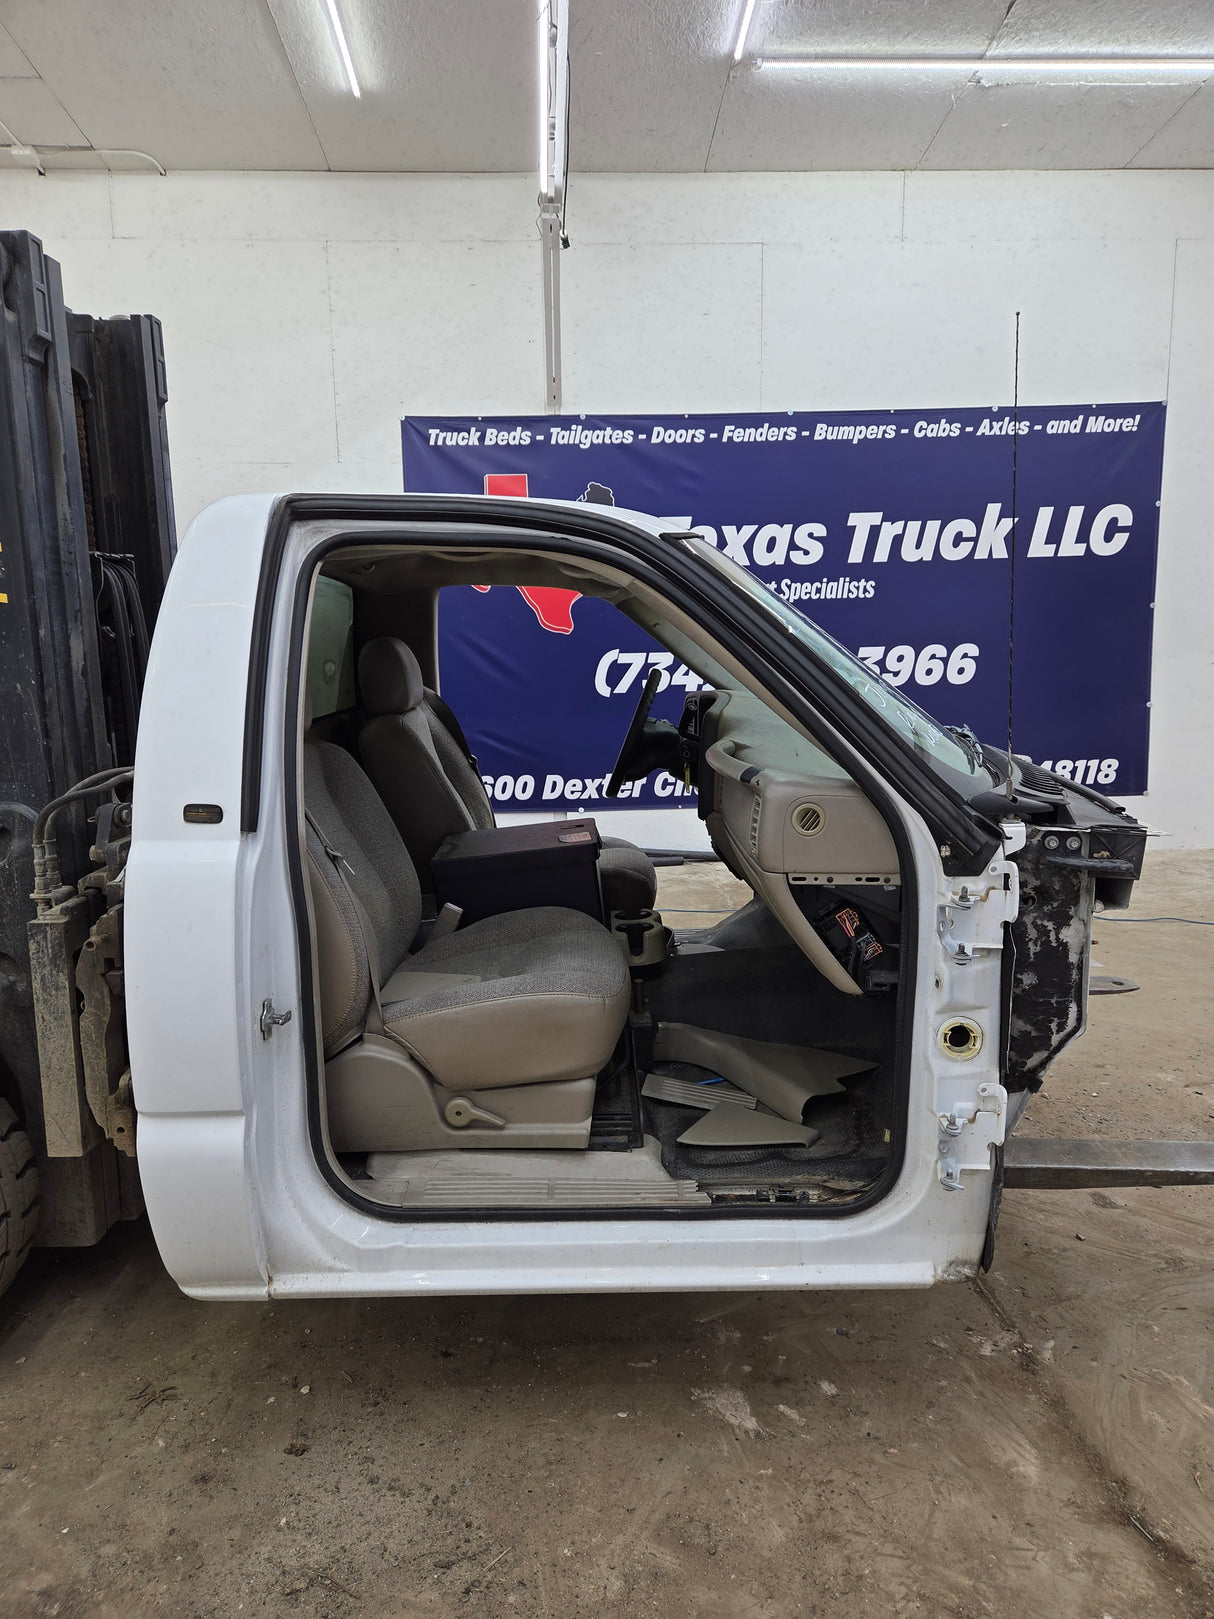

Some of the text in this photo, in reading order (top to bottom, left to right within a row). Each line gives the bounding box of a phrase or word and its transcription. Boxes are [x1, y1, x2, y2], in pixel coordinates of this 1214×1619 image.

[428, 427, 481, 446] Truck
[483, 427, 532, 446] Beds
[549, 425, 634, 449] Tailgates
[650, 426, 705, 444] Doors
[721, 423, 798, 443] Fenders
[813, 423, 897, 444] Bumpers
[913, 419, 962, 438] Cabs
[976, 416, 1030, 436] Axles
[1046, 414, 1083, 434] and
[1085, 414, 1142, 434] More!
[659, 502, 1134, 567] xas Truck LLC
[780, 576, 876, 603] Specialists
[594, 648, 715, 697] (734
